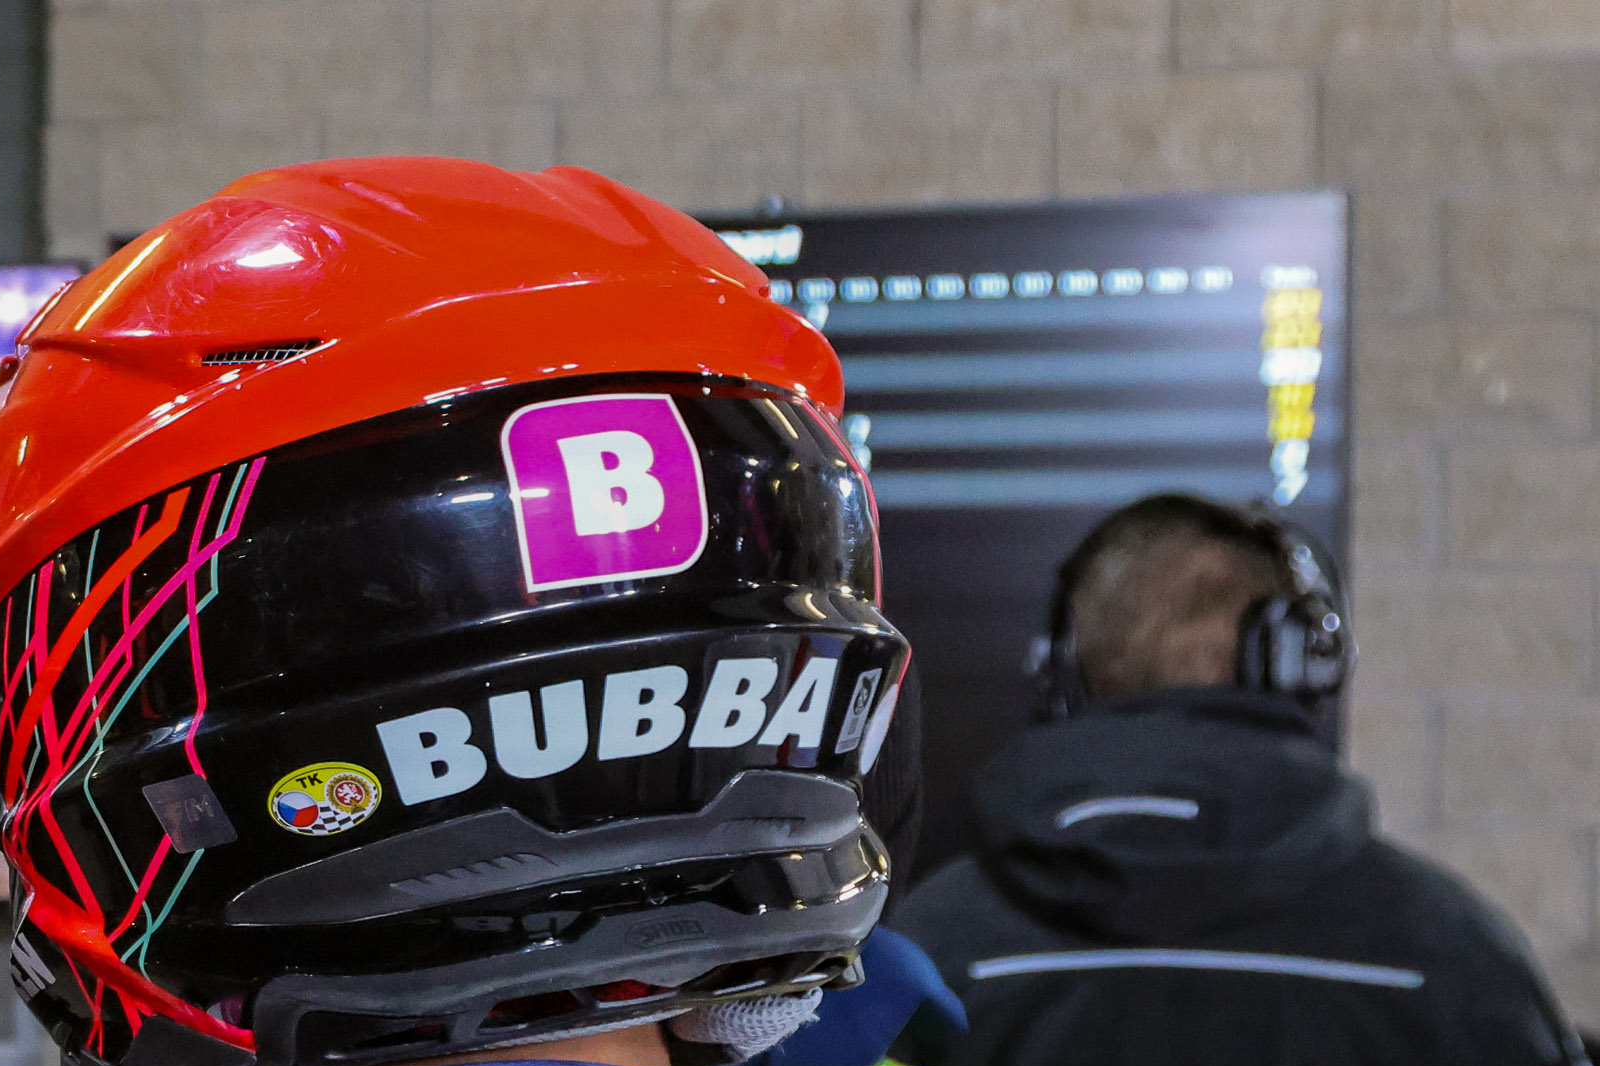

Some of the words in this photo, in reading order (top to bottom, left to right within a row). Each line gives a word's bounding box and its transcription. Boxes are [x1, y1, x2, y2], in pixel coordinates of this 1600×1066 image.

[557, 430, 665, 537] B
[296, 772, 324, 789] TK
[375, 657, 839, 807] BUBBA
